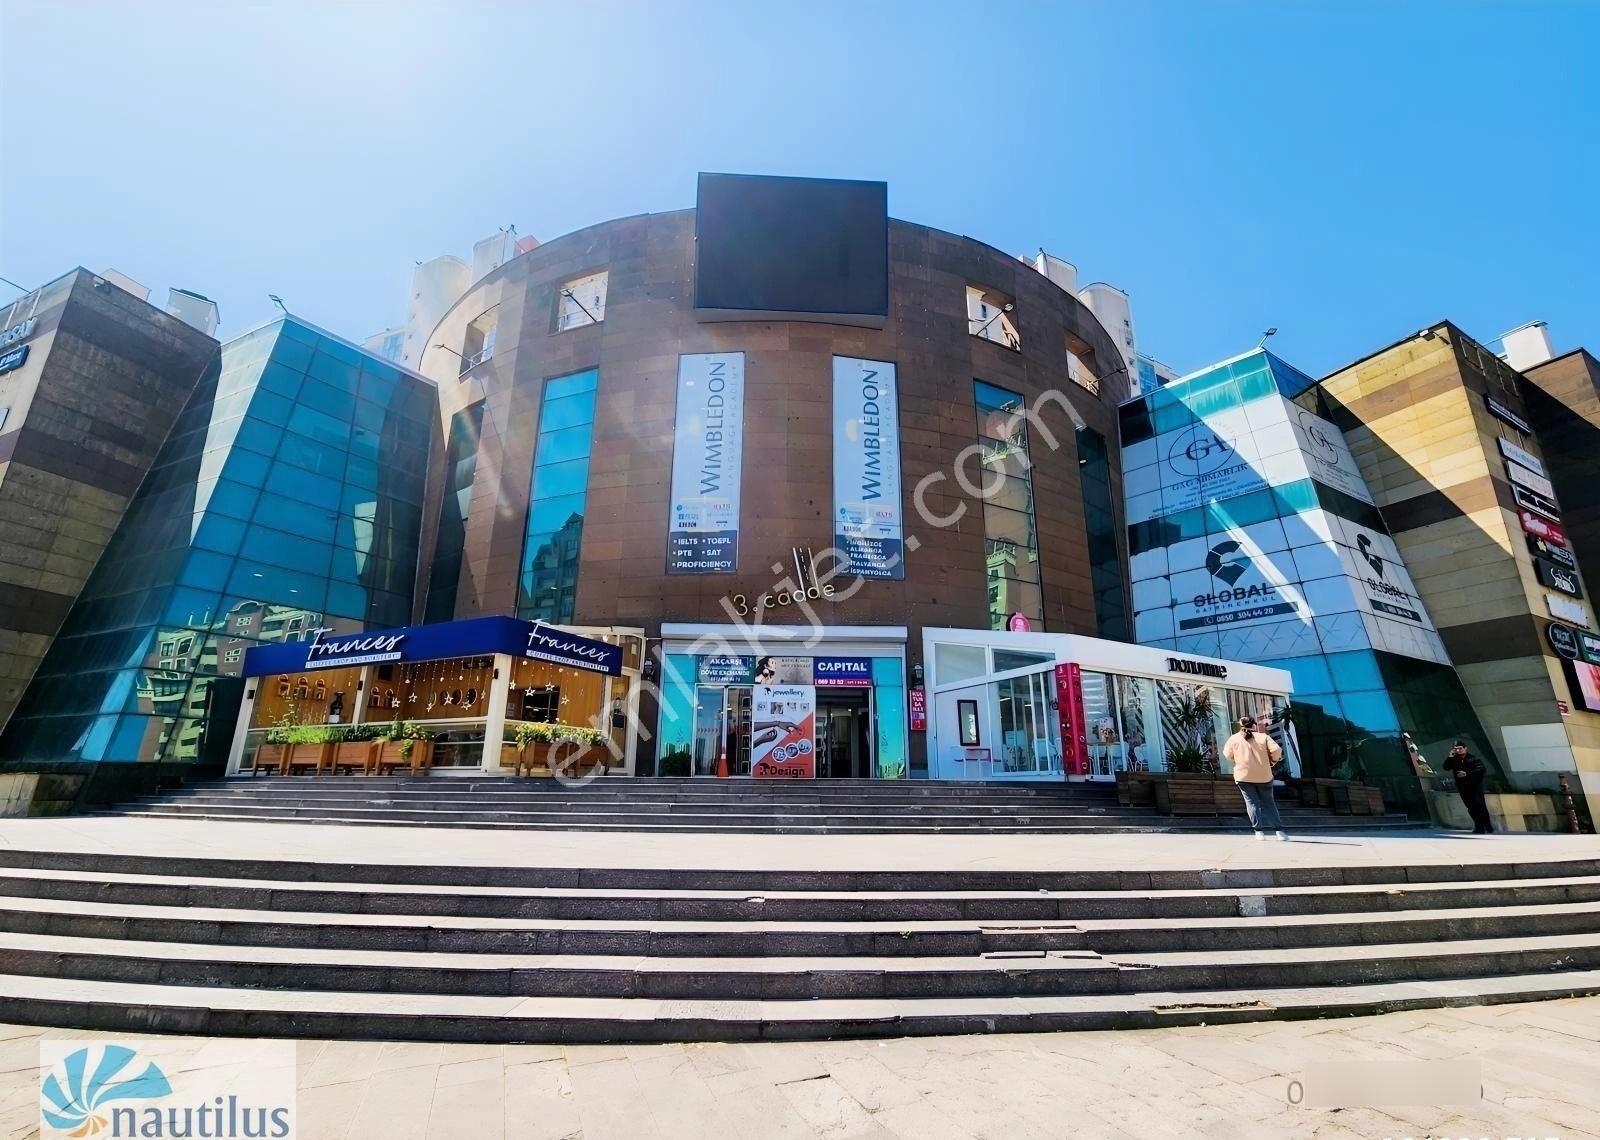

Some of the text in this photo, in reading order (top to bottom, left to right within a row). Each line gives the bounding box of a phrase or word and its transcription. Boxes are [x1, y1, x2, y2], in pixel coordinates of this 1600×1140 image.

[700, 361, 726, 495] WIMBLEDON
[862, 369, 881, 500] WIMBLEDON
[677, 560, 732, 568] PROFICIENCY
[1194, 582, 1276, 607] GLOBAL
[1264, 607, 1274, 615] 20
[308, 626, 405, 661] Frances
[527, 619, 610, 662] Frances
[710, 658, 742, 666] AKÇARŞI
[817, 662, 867, 671] CAPITAL
[773, 688, 804, 697] jewellery
[770, 765, 805, 778] Design
